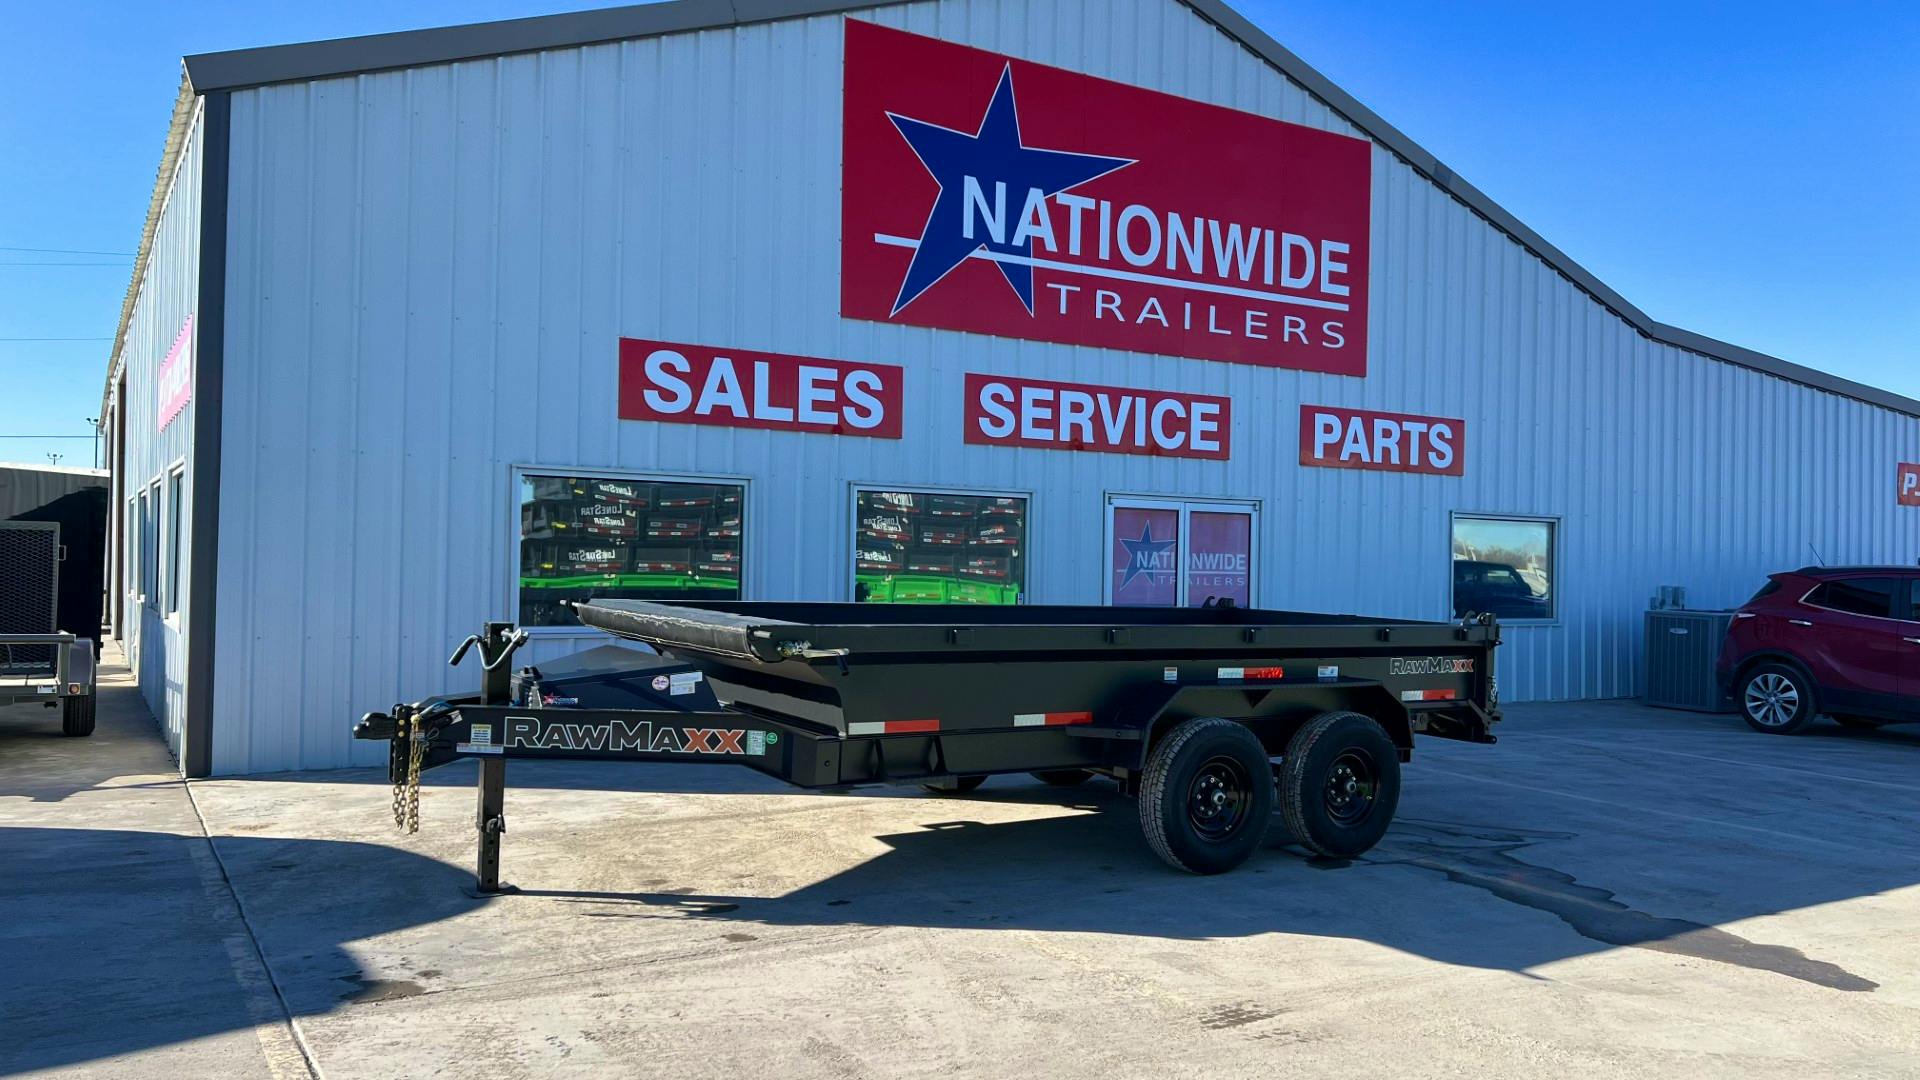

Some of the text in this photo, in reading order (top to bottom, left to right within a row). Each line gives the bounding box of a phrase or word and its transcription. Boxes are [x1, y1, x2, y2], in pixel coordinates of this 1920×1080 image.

[963, 175, 1350, 296] NATIONWIDE
[1047, 283, 1345, 348] TRAILERS
[643, 350, 884, 428] SALES
[979, 382, 1220, 451] SERVICE
[1314, 413, 1453, 468] PARTS
[1903, 472, 1920, 496] P
[1137, 551, 1246, 570] NATINWIDE
